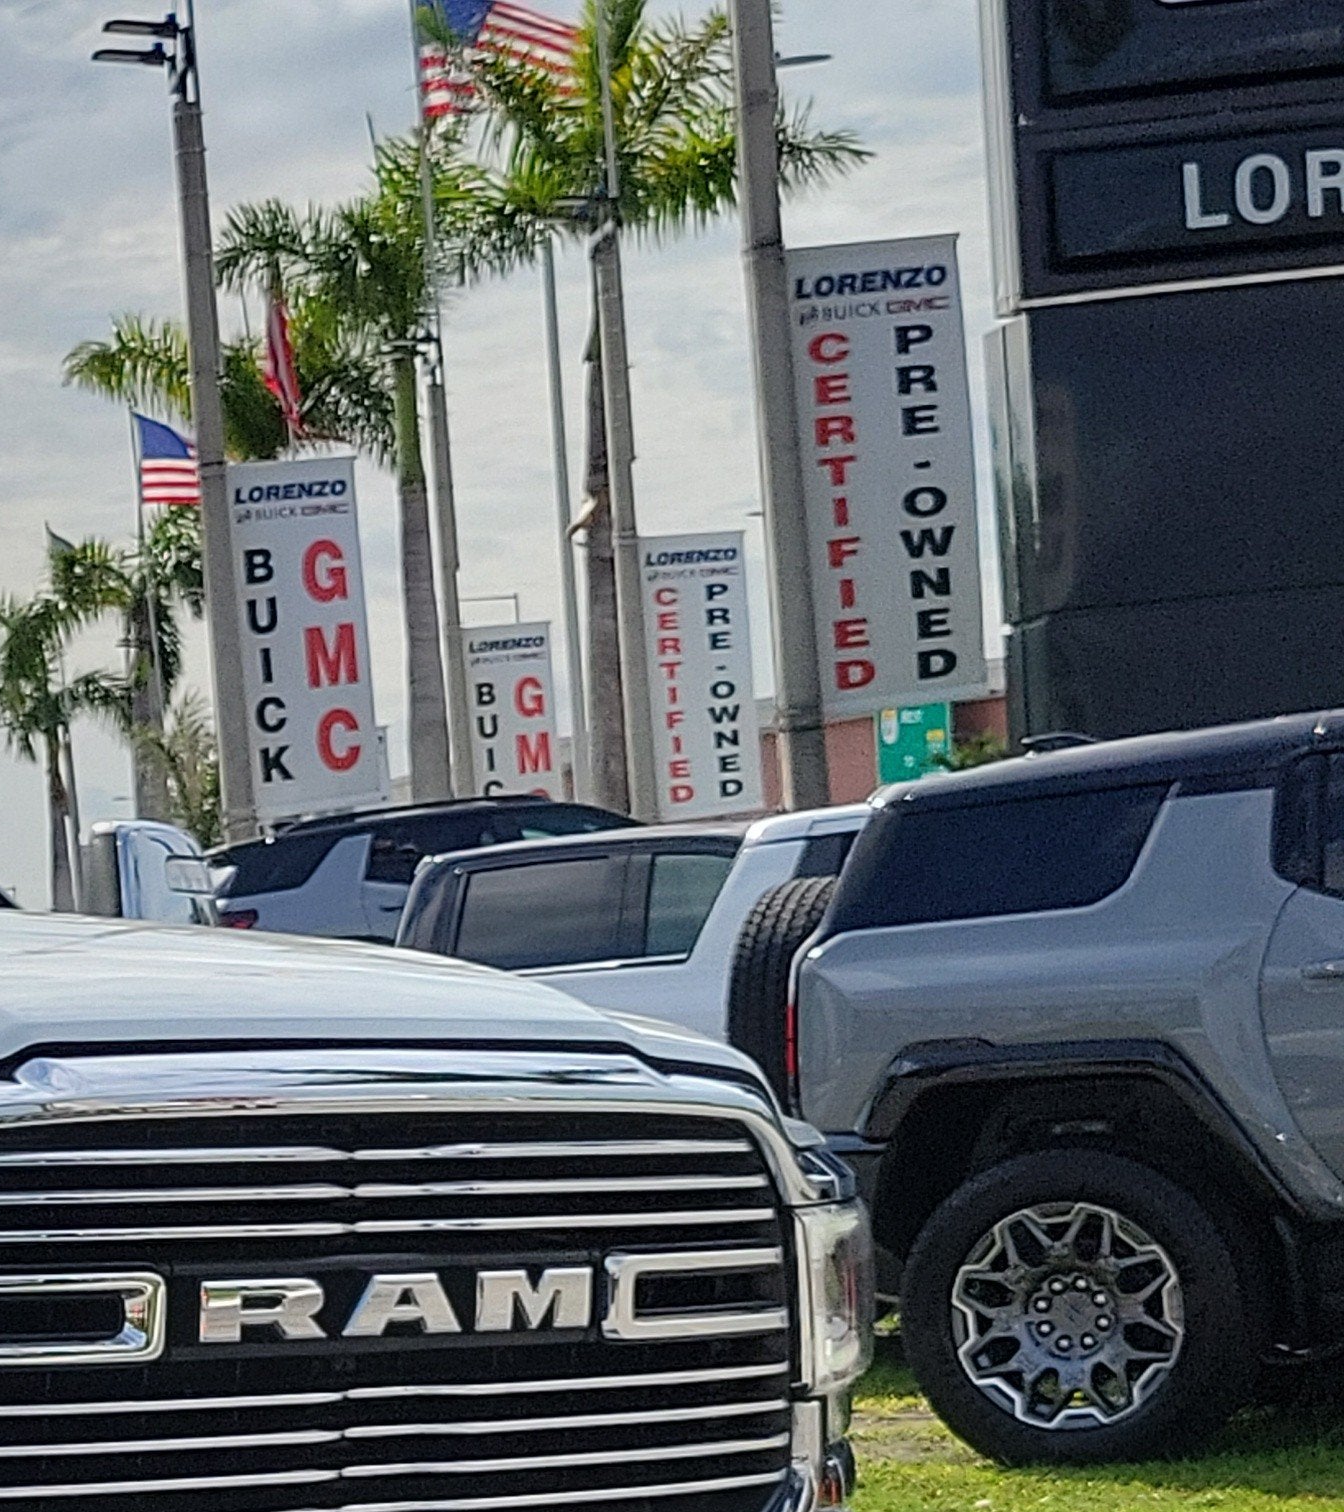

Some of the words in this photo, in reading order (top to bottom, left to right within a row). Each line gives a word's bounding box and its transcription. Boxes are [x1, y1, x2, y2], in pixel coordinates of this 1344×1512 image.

[794, 264, 947, 299] LORENZO
[822, 302, 881, 322] BUICK
[886, 295, 951, 315] GMC
[234, 479, 347, 505] LORENZO
[255, 506, 297, 521] BUICK
[808, 332, 876, 691] CERTIFIED
[893, 324, 957, 680] PRE-OWNED
[645, 548, 738, 567] LORENZO
[244, 548, 295, 783] BUICK
[302, 539, 361, 773] GMC
[469, 635, 545, 653] LORENZO
[705, 583, 743, 798] PRE-OWNED
[514, 676, 551, 798] GM
[654, 587, 694, 804] CERTIFIED
[198, 1267, 593, 1343] RAM
